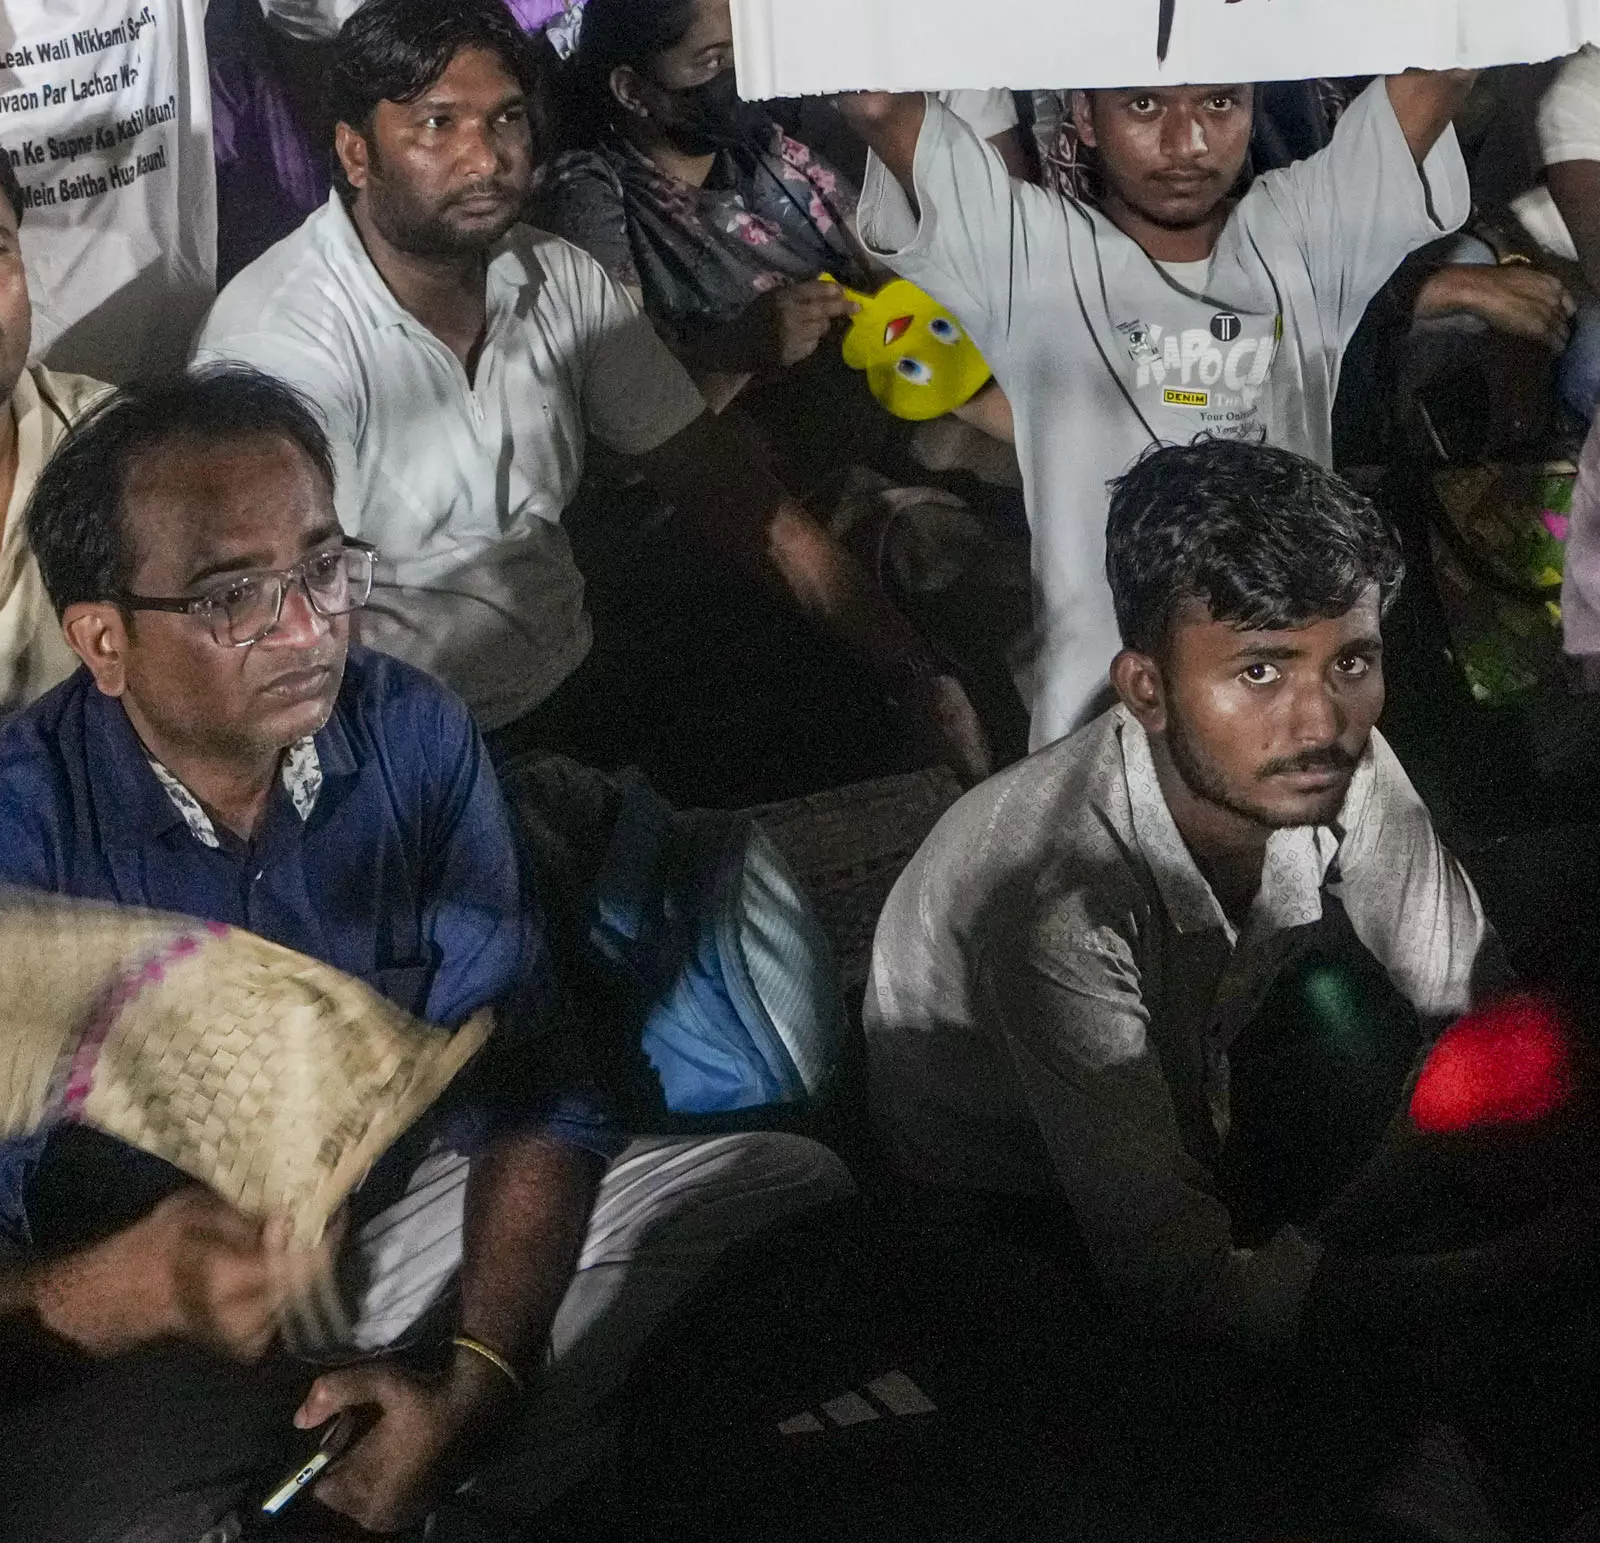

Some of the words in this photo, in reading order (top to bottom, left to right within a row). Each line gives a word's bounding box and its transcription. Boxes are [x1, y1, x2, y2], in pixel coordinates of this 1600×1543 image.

[36, 38, 71, 64] Wali
[72, 20, 127, 56] Nikkami
[42, 83, 67, 107] Par
[71, 71, 119, 101] Lachar
[23, 140, 46, 166] Ke
[47, 133, 93, 162] Sapne
[95, 127, 116, 152] Ka
[59, 171, 109, 203] Baitha
[1166, 391, 1205, 403] DENIM
[1200, 411, 1223, 422] Your
